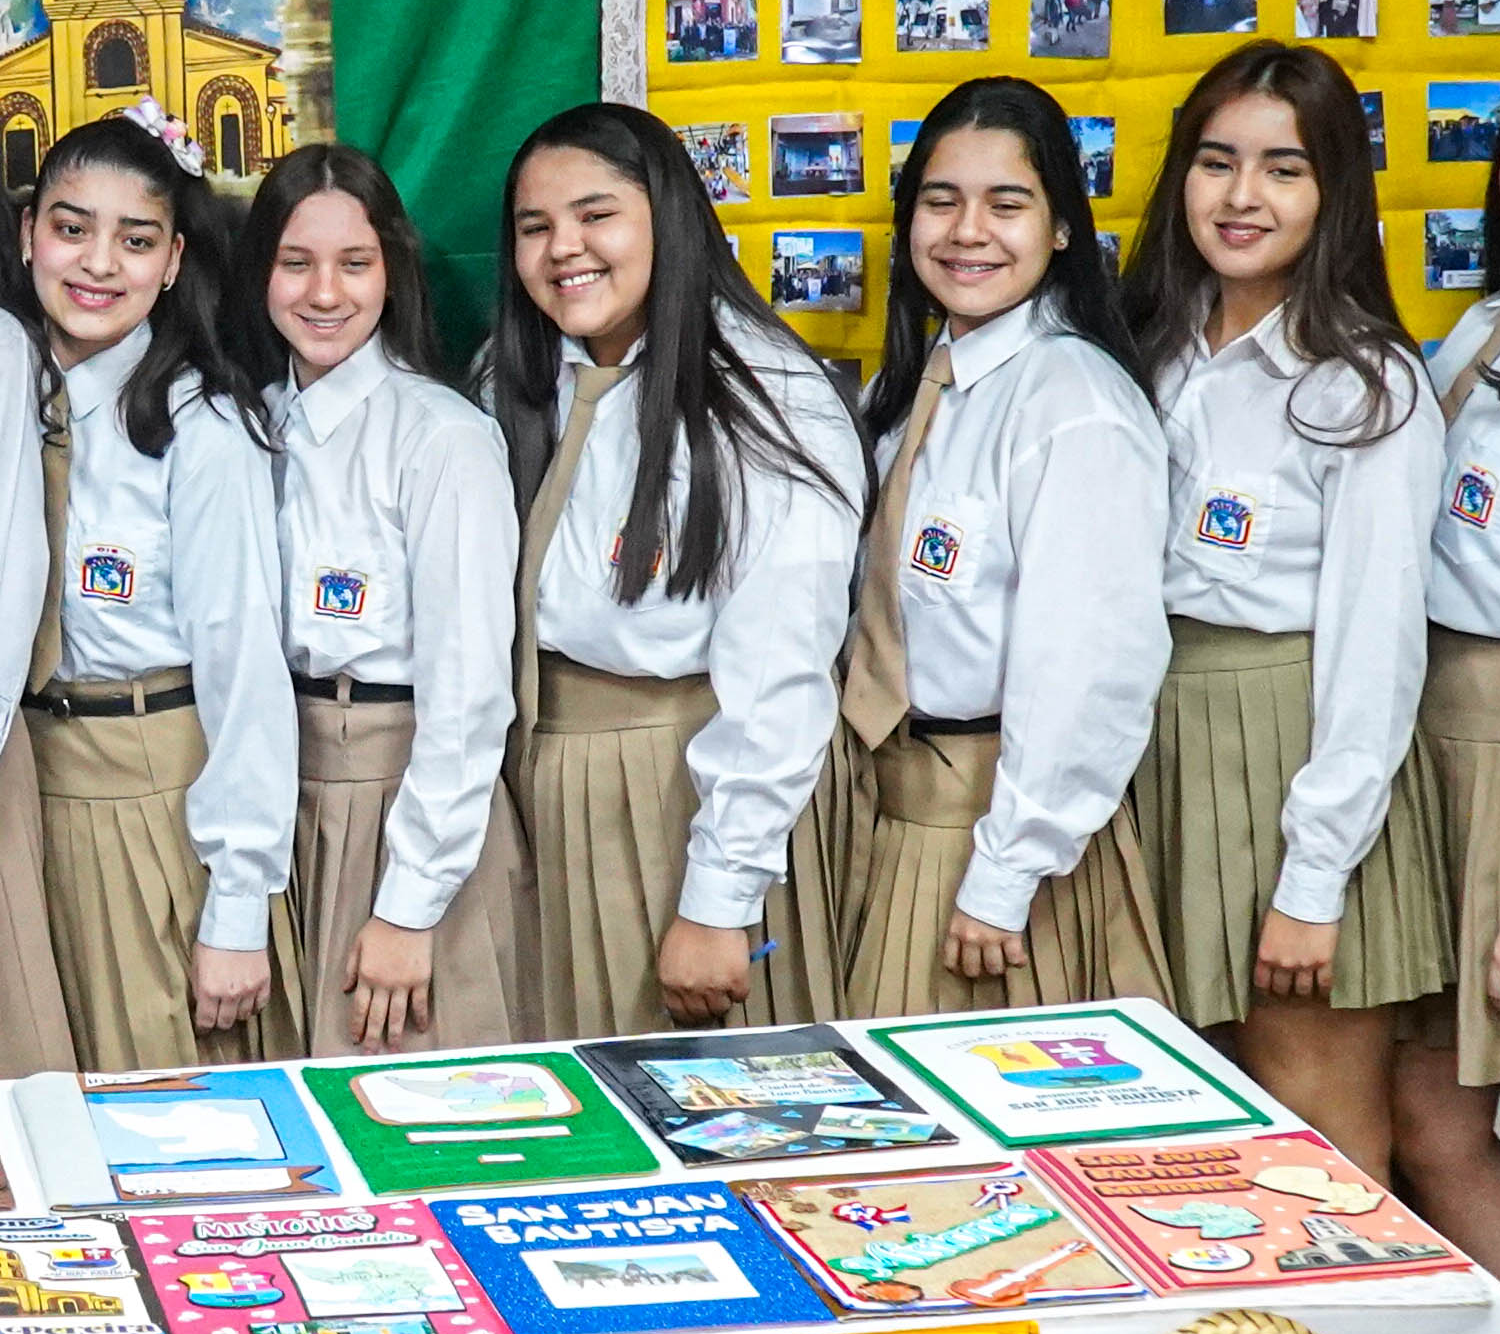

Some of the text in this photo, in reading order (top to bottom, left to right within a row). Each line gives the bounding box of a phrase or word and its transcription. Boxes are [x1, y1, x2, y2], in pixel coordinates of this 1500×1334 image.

[1008, 1088, 1202, 1110] SAN JUAN BAUTISTA
[1075, 1149, 1241, 1167] SAN JUAN
[1085, 1164, 1240, 1181] BAUTISTA
[1094, 1179, 1253, 1197] MISIONES
[456, 1193, 728, 1226] SAN JUAN
[198, 1214, 376, 1238] MISIONES
[484, 1215, 740, 1244] BAUTISTA
[183, 1232, 411, 1254] San Juan Bautista
